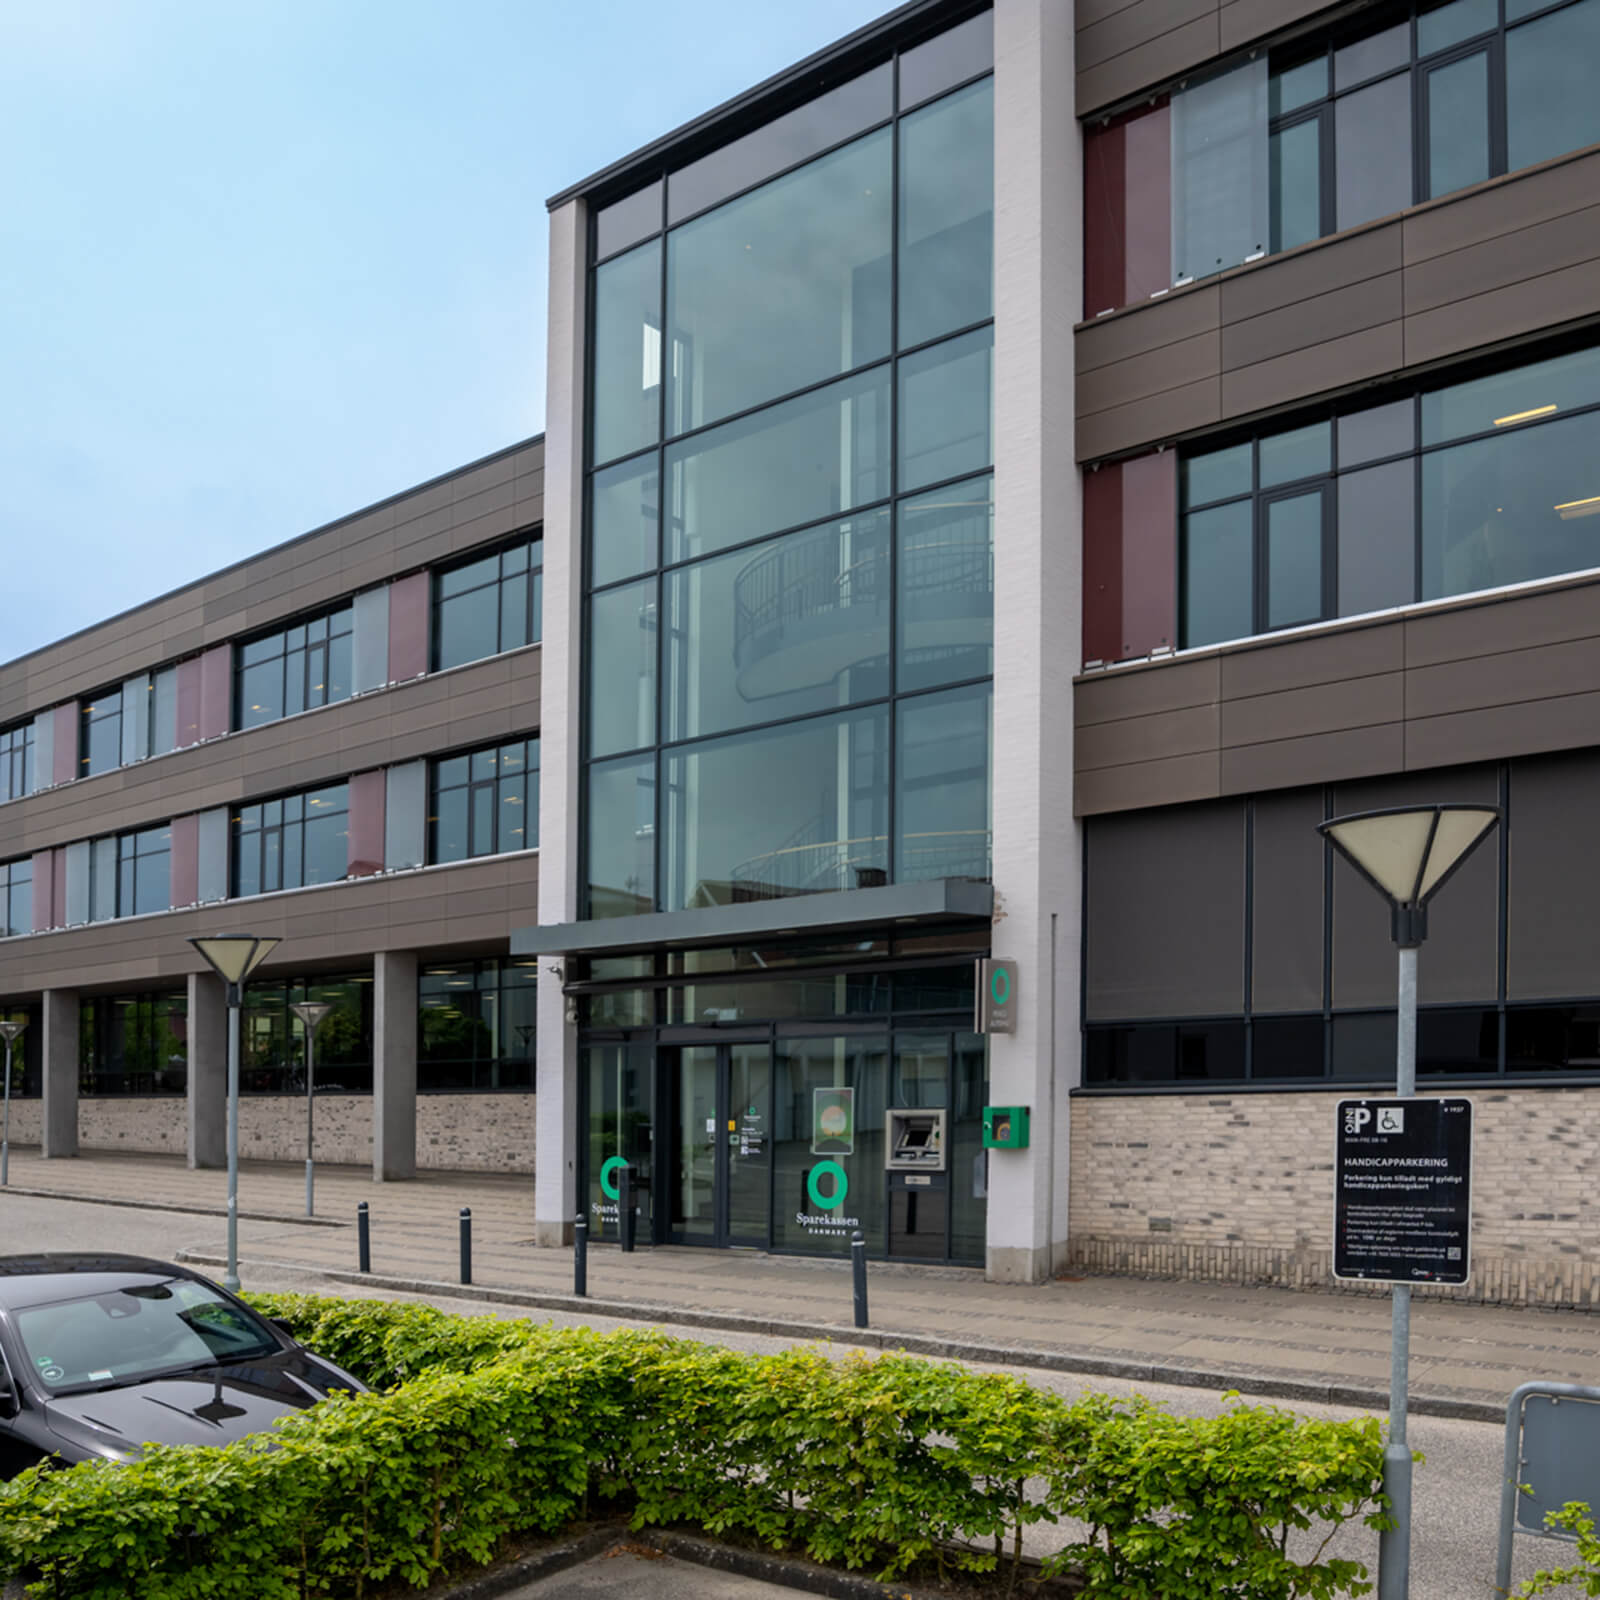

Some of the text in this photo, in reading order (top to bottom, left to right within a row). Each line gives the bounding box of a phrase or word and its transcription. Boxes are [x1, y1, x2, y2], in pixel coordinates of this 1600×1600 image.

[1354, 1107, 1371, 1134] P
[1344, 1158, 1448, 1168] HANDICAPPARKERING
[1344, 1174, 1378, 1183] Parkering
[1380, 1174, 1393, 1182] kun
[1394, 1174, 1417, 1182] tilladt
[1435, 1175, 1463, 1184] gyldigt
[796, 1212, 859, 1227] Sparekassen
